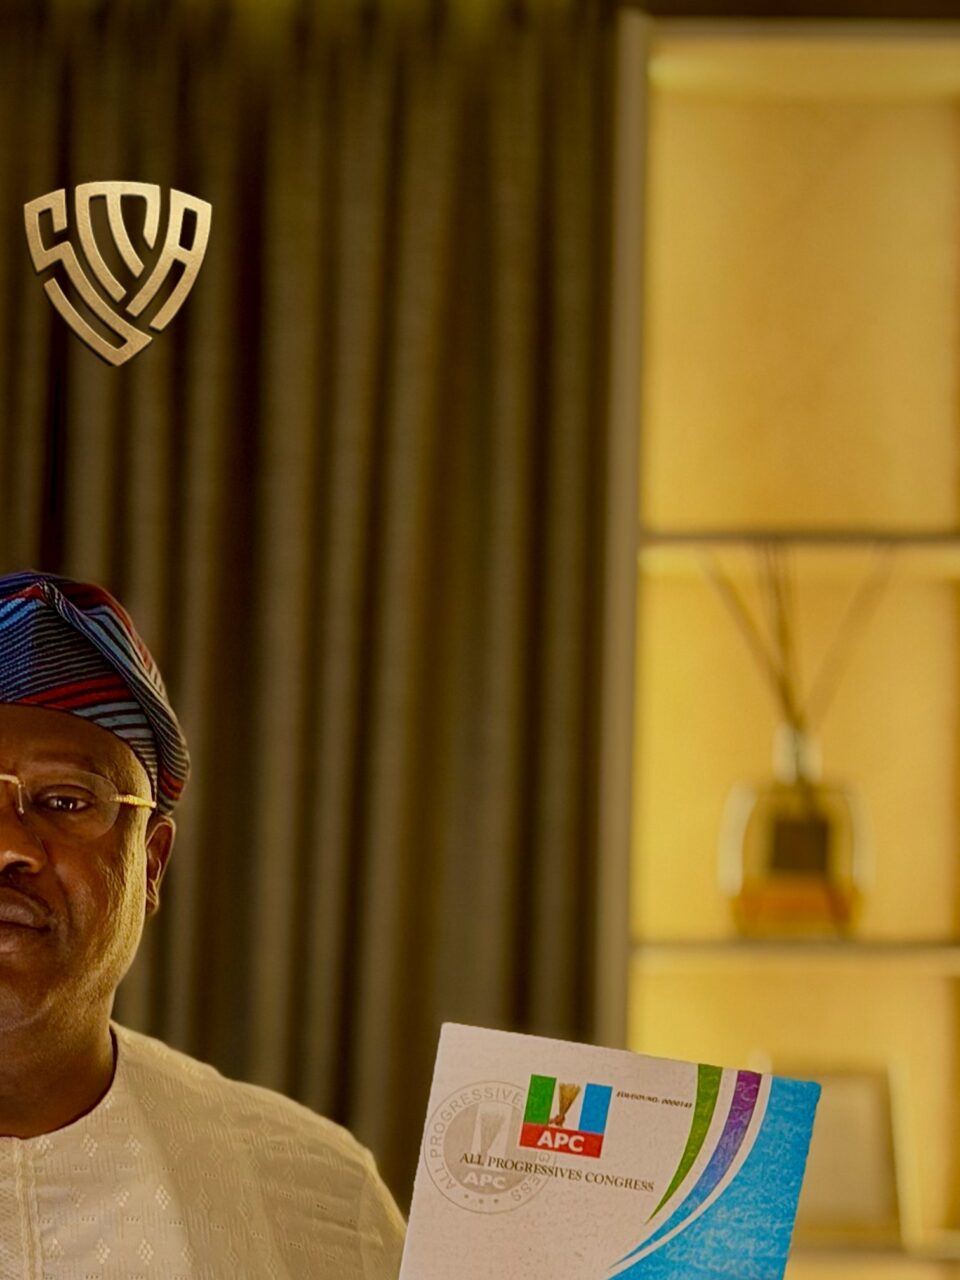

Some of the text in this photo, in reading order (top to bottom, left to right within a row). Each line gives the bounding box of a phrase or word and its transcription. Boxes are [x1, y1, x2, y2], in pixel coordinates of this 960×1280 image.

[429, 1087, 523, 1159] PROGRESSIVE
[536, 1130, 585, 1153] APC
[459, 1153, 655, 1192] ALL PROGRESSIVES CONGRESS
[462, 1171, 508, 1189] APC
